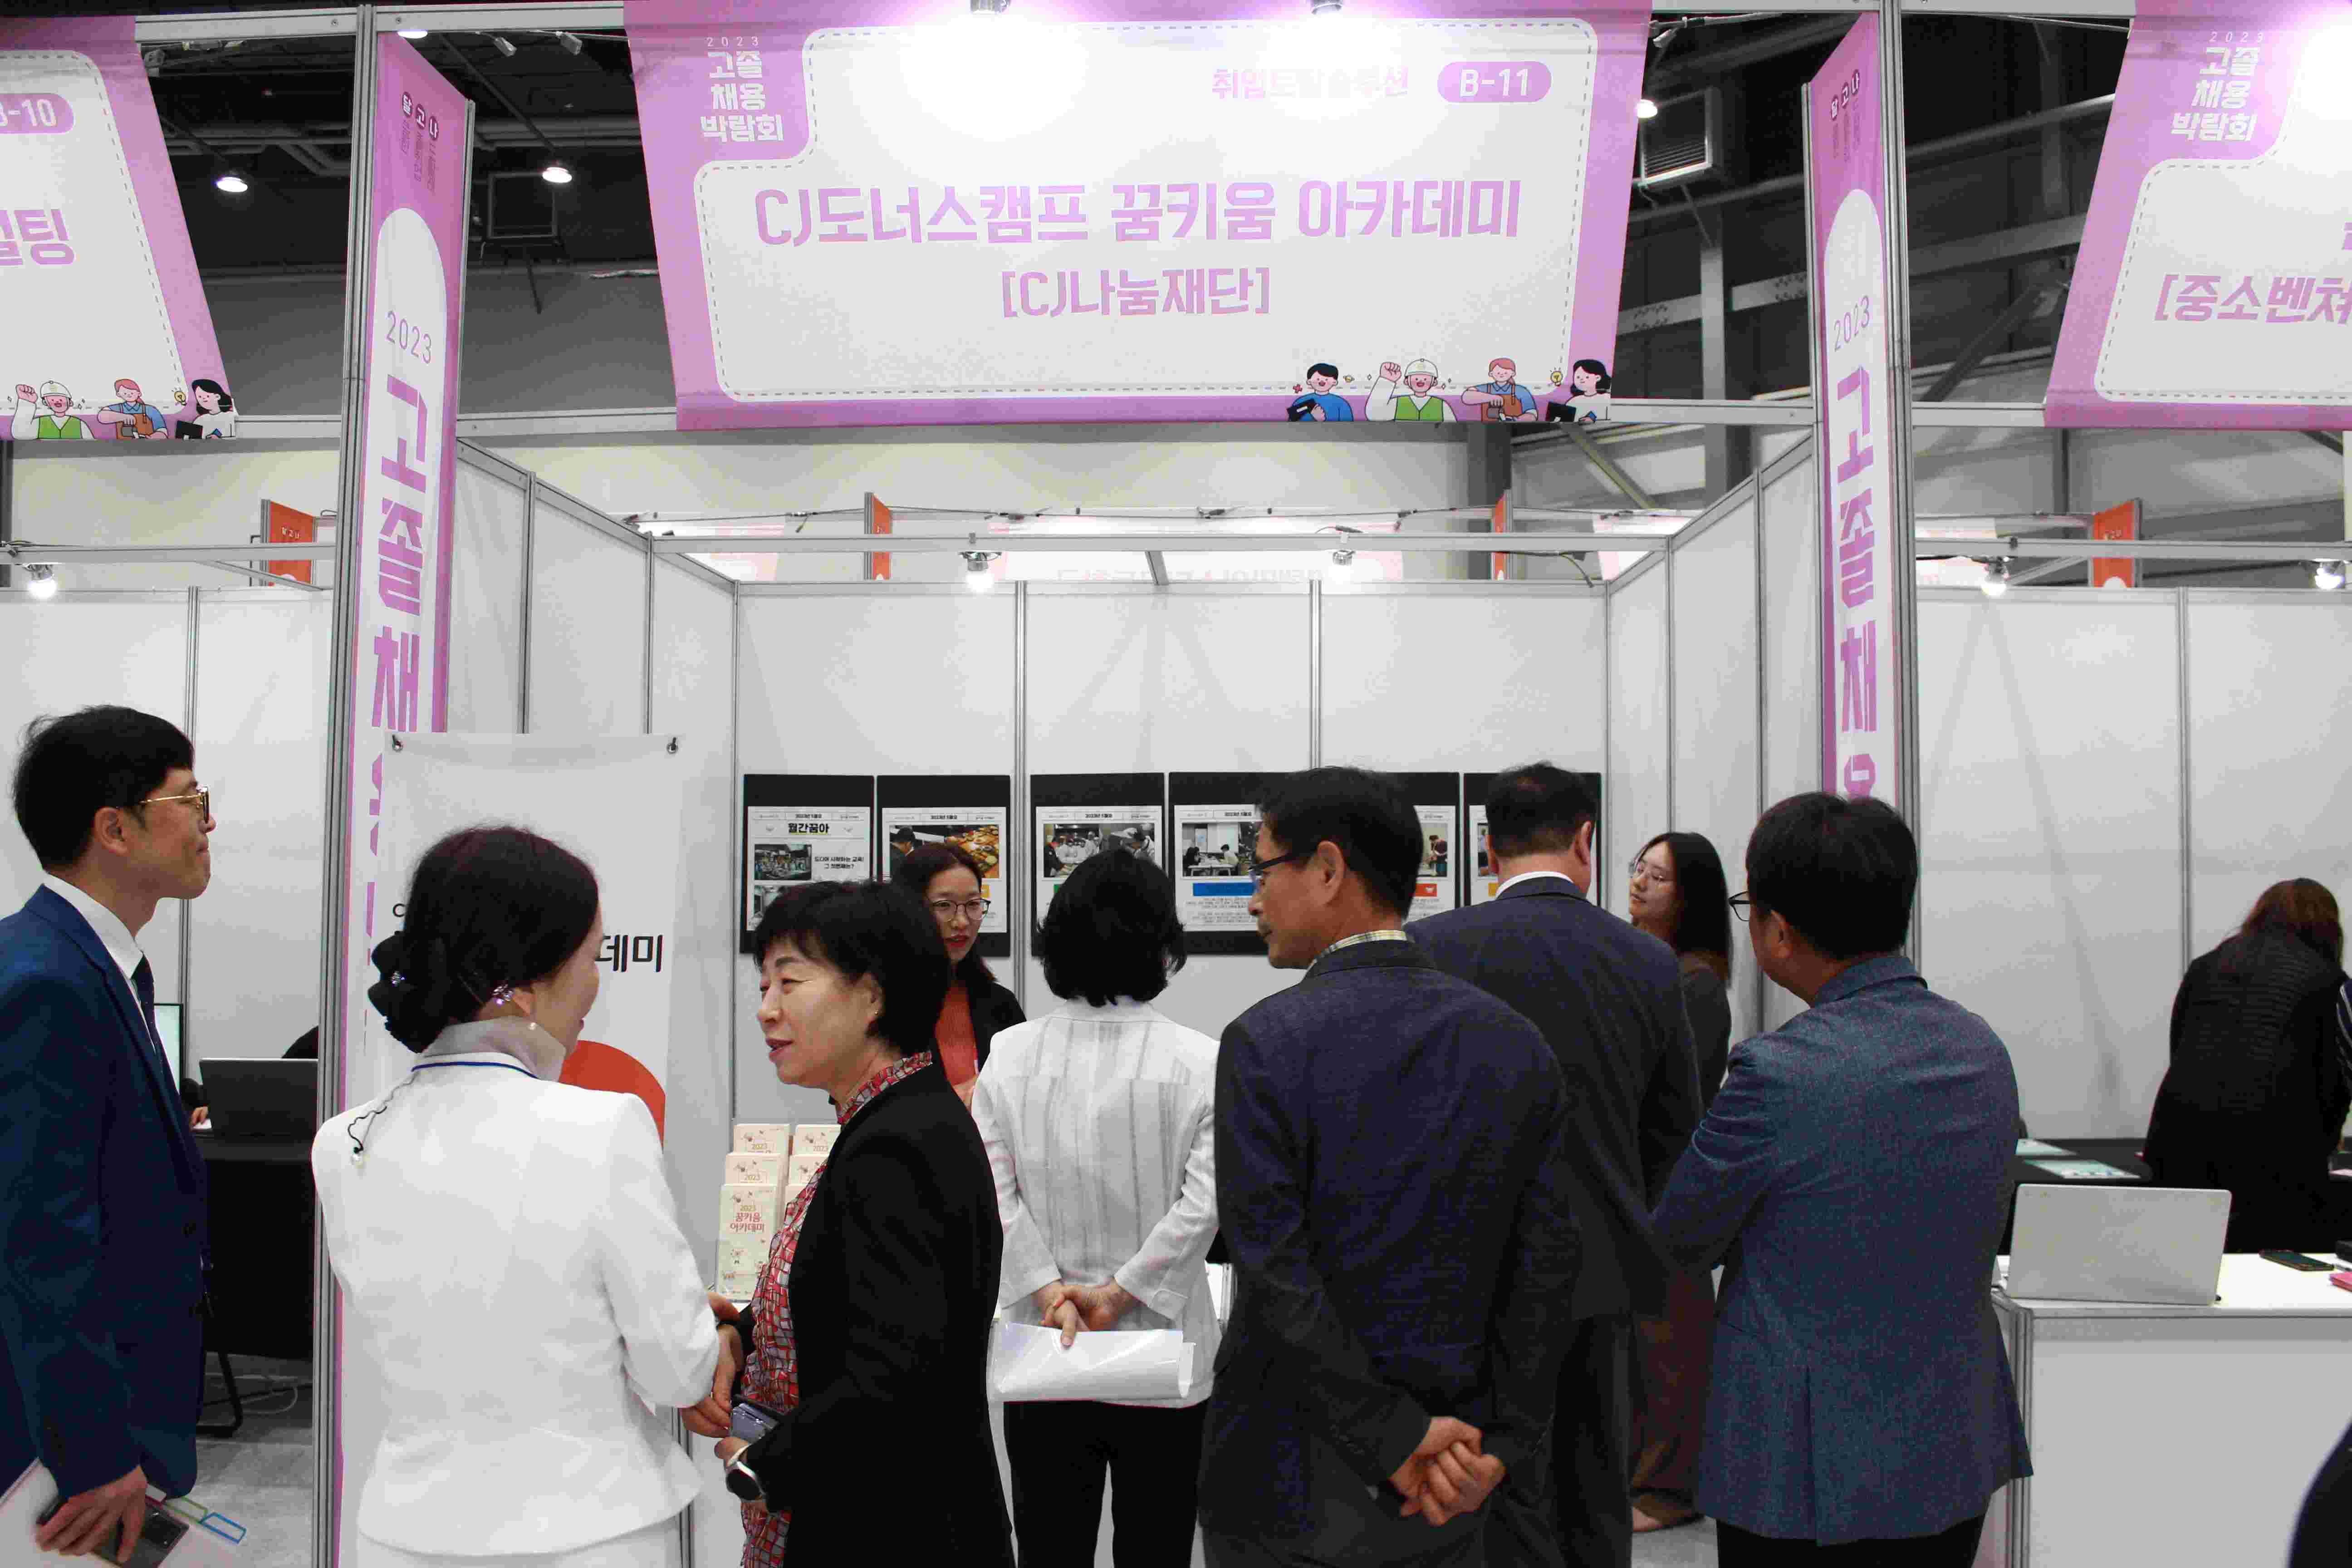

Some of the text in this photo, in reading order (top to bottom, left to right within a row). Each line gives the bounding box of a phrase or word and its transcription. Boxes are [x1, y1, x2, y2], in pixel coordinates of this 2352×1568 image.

[706, 36, 759, 47] 2023
[2209, 31, 2263, 44] 2023
[707, 51, 763, 79] 고졸
[2200, 47, 2260, 76] 고졸
[710, 83, 765, 110] 채용
[1459, 68, 1530, 98] B-11
[2191, 80, 2249, 109] 채용
[701, 114, 784, 142] 박람회
[2171, 113, 2258, 142] 박람회
[755, 179, 1521, 247] CJ도너스캠프 꿈키움 아카데미
[1002, 267, 1270, 318] [CJ나눔재단]
[385, 310, 432, 364] 2023
[1834, 295, 1870, 352] 2023
